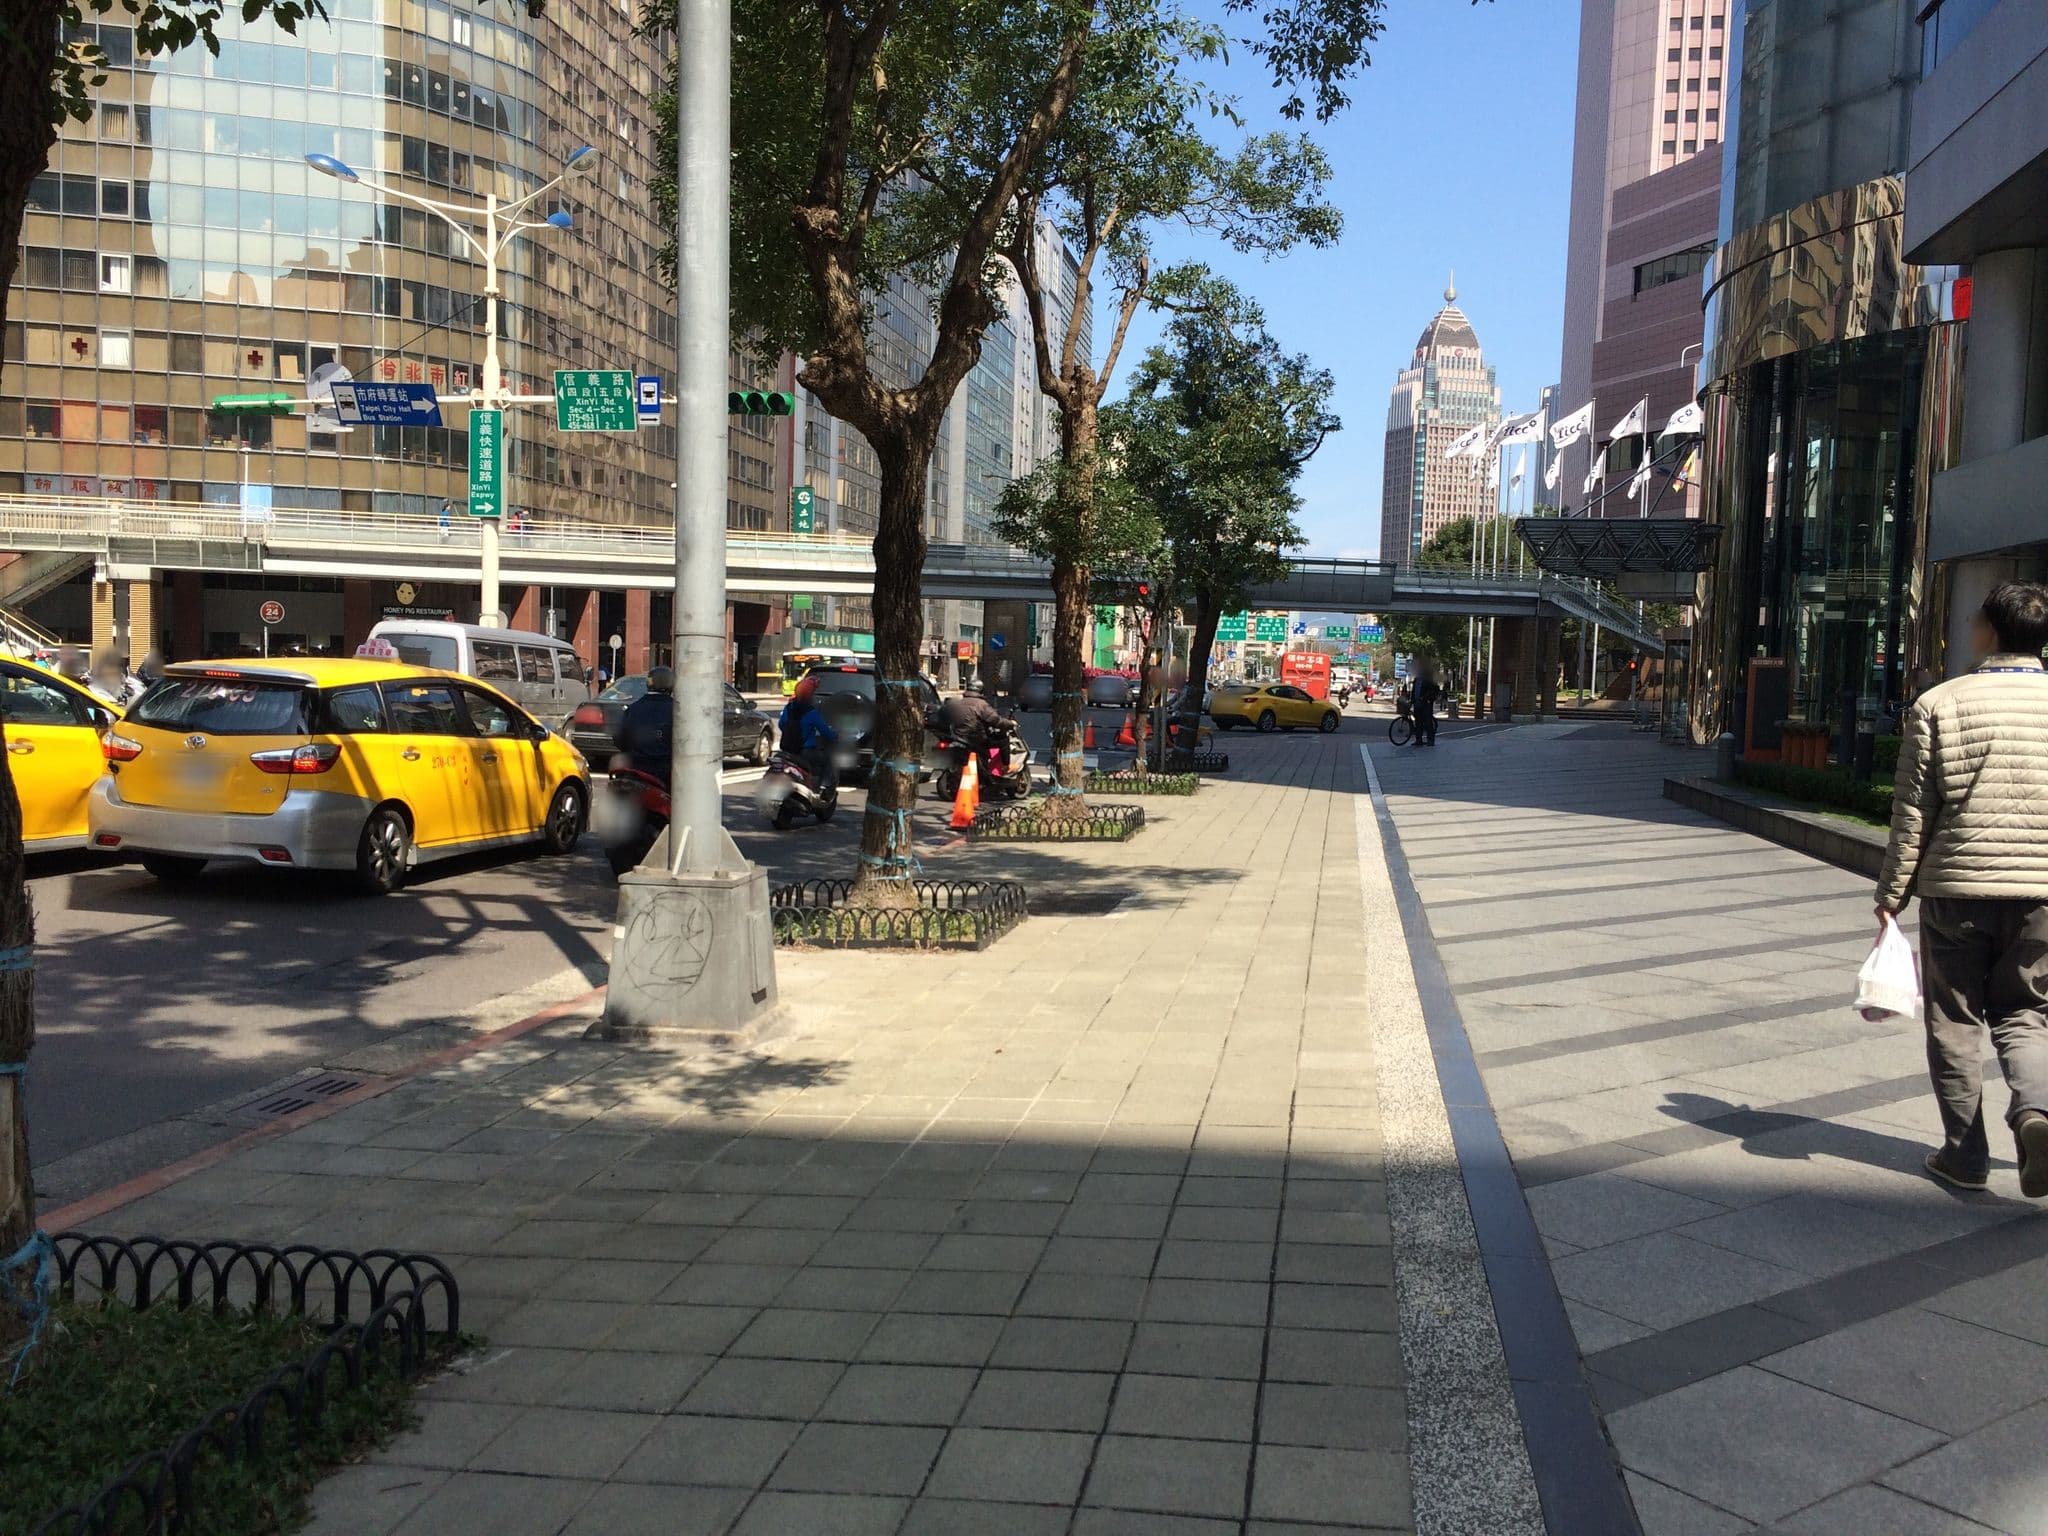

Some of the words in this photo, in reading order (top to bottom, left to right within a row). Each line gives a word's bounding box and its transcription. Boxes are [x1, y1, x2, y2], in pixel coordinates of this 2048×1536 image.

[563, 373, 624, 386] 信義路
[356, 388, 409, 402] 市府轉運站
[567, 388, 591, 397] 四段
[600, 388, 622, 397] 五段
[576, 398, 598, 406] XinYi
[360, 404, 380, 413] Taipei
[383, 405, 396, 413] City
[399, 405, 412, 413] Hall
[569, 406, 585, 414] Sec.
[363, 414, 376, 422] Bus
[378, 414, 402, 422] Station
[479, 412, 493, 482] 信義快速道路
[471, 492, 495, 500] Expwy
[266, 608, 279, 616] 24
